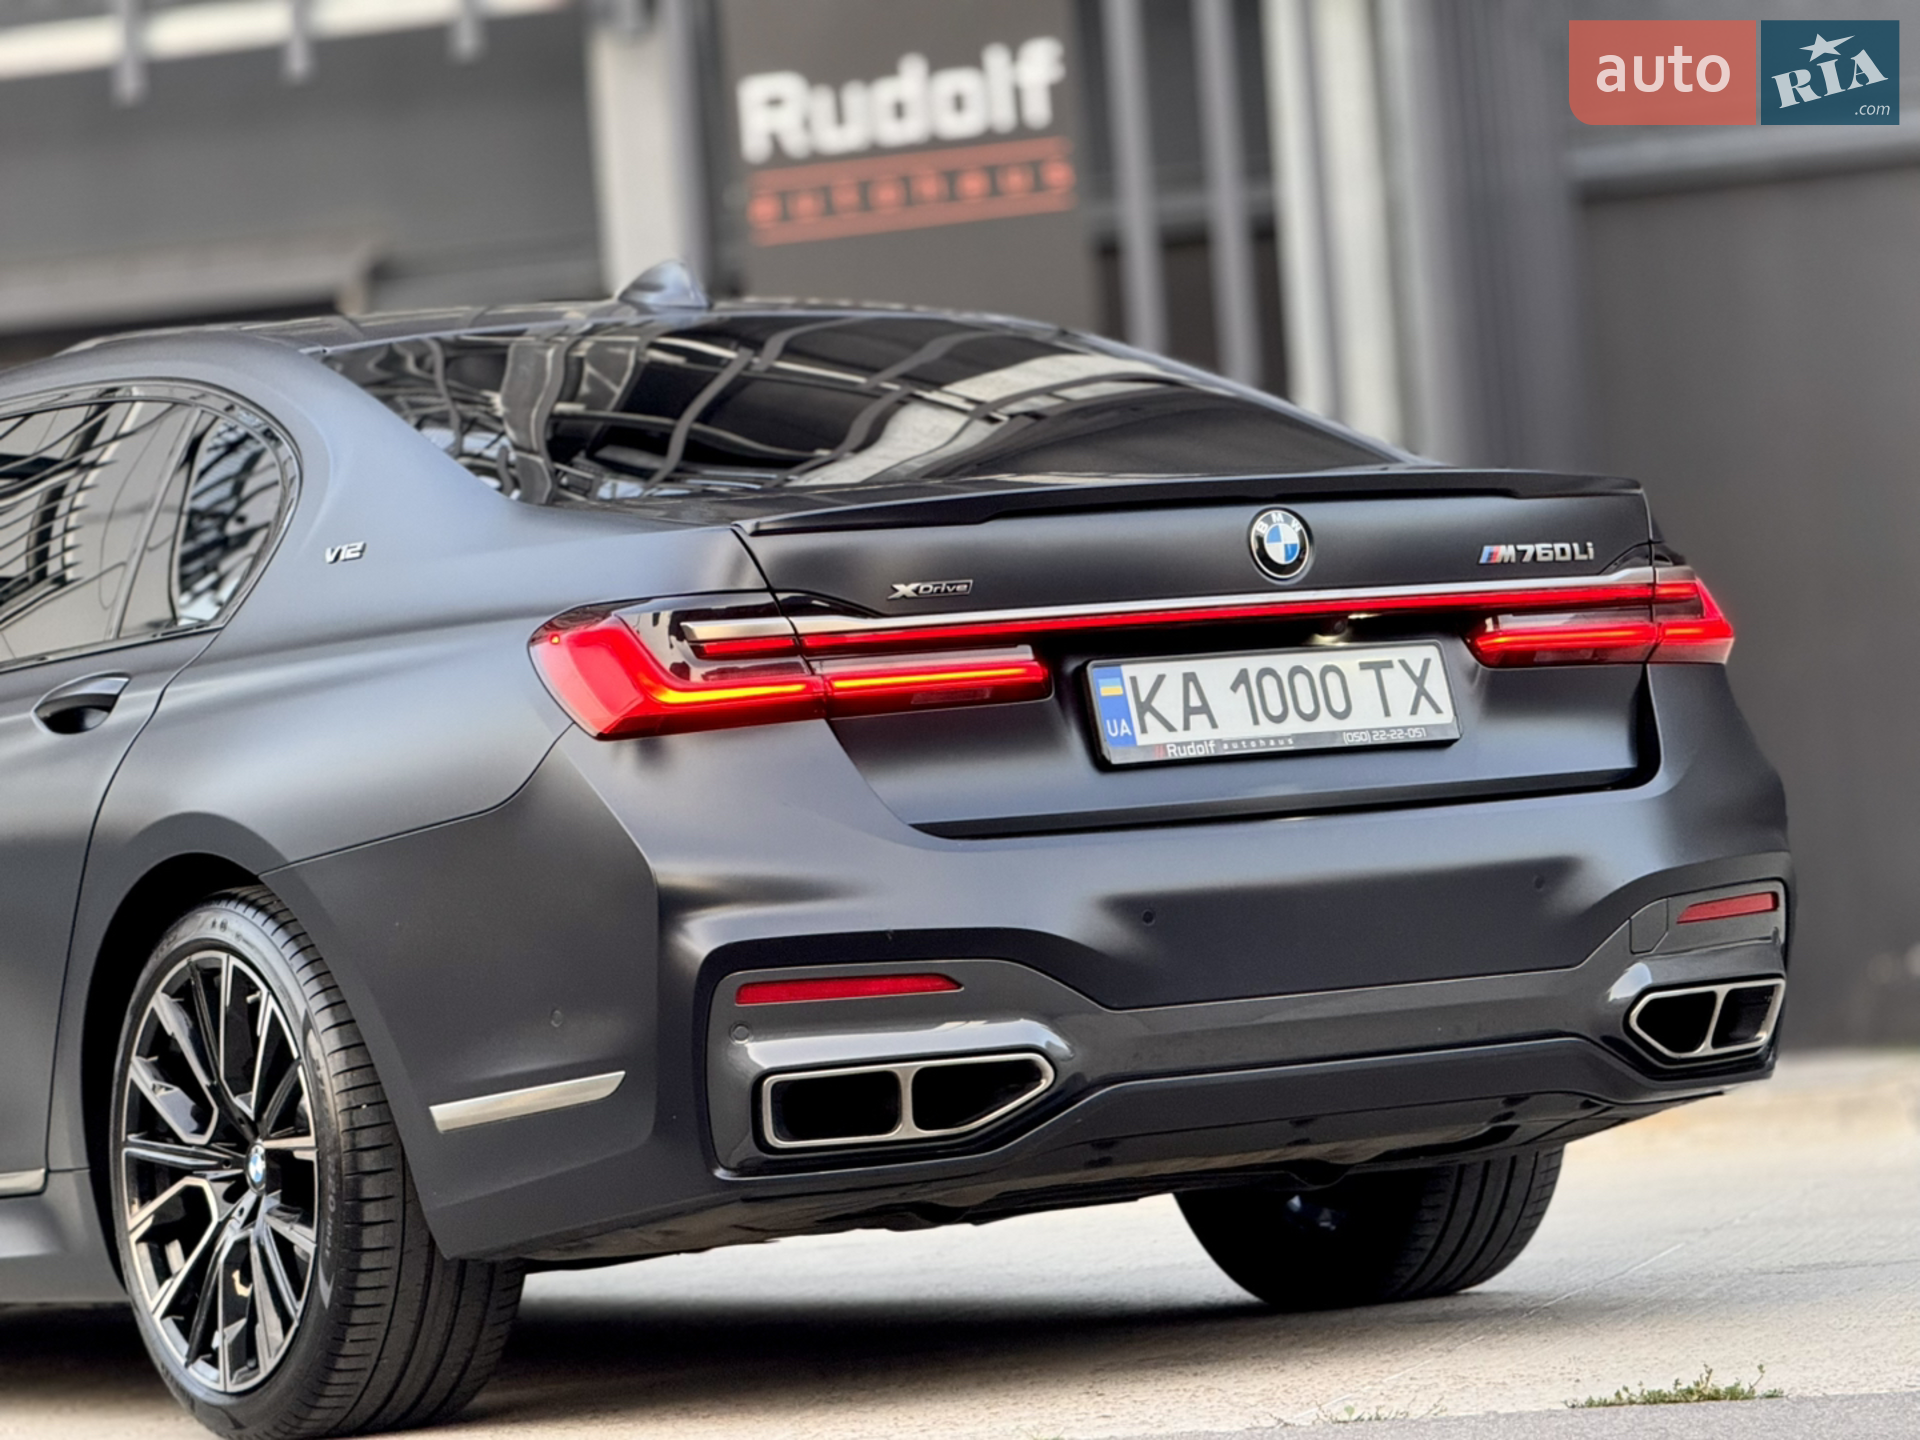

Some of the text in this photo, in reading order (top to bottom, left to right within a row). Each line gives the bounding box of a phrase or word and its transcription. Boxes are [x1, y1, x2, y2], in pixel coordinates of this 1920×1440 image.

[737, 35, 1066, 164] Rudolf
[1256, 511, 1302, 535] BMW
[325, 541, 366, 564] V12
[1129, 658, 1444, 734] KA 1000 TX
[1106, 718, 1132, 737] UA
[1166, 740, 1216, 758] Rudolf
[1222, 737, 1294, 750] autohaus
